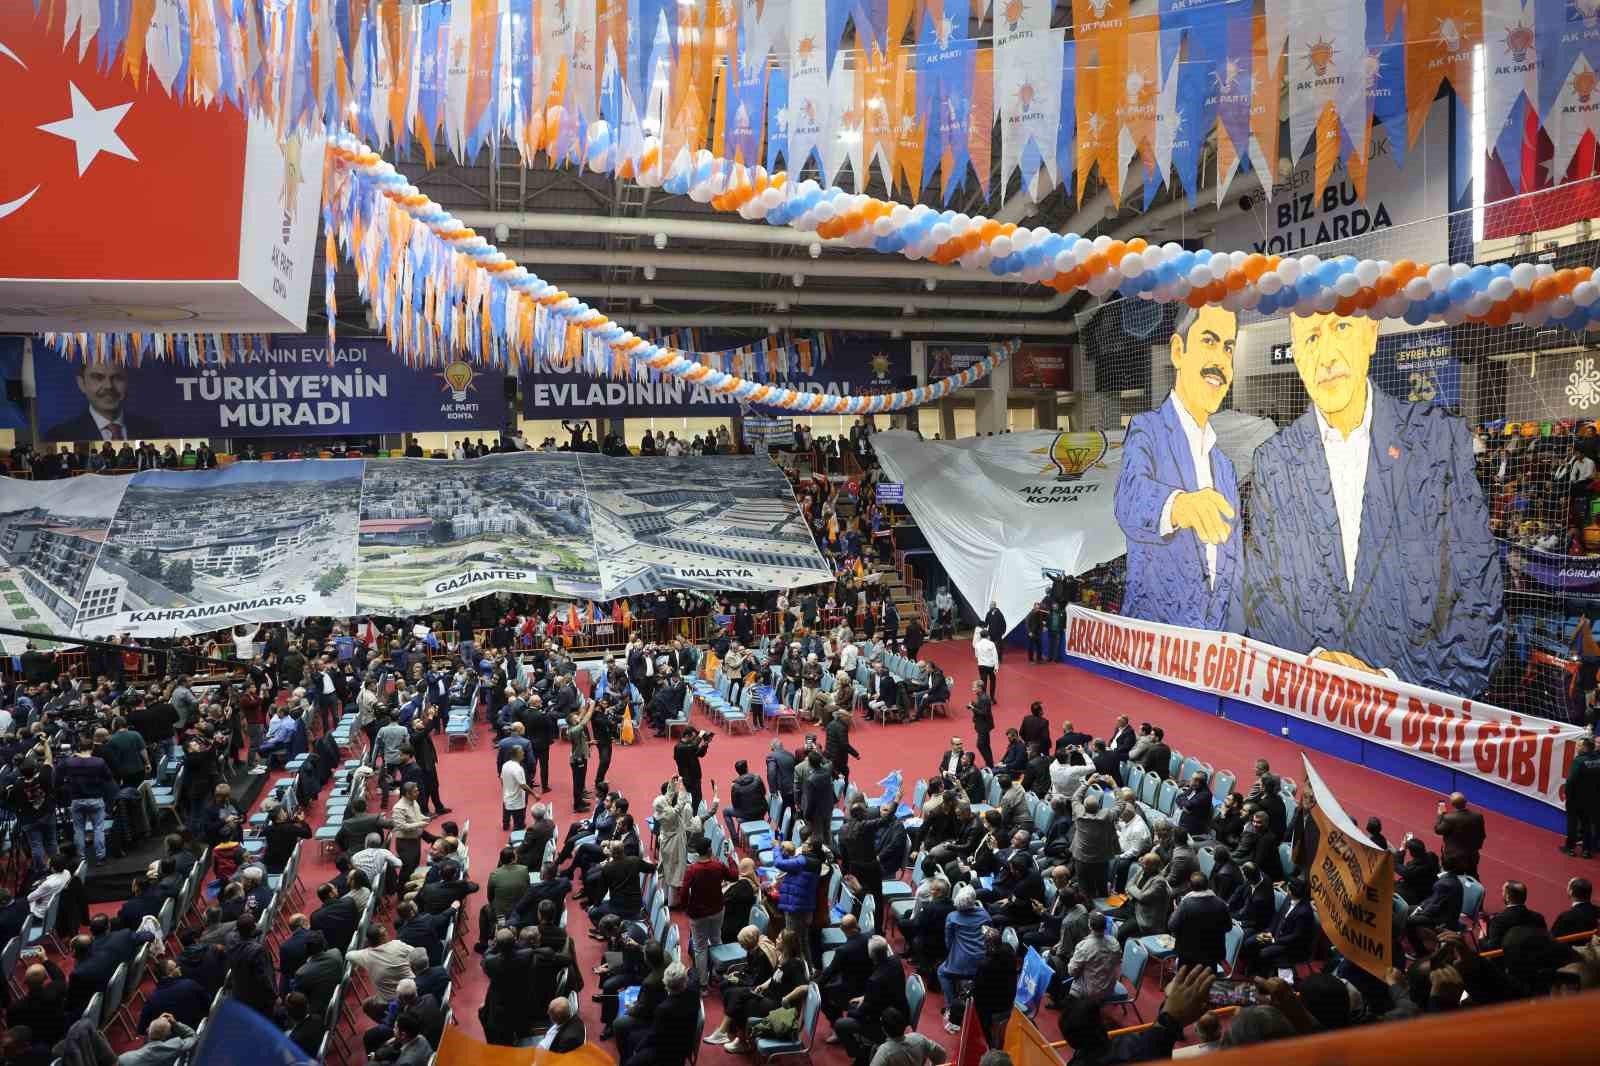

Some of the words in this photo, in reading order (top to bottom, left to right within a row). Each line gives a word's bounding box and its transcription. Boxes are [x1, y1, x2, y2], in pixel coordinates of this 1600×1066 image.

[1297, 81, 1312, 91] AK
[1277, 192, 1315, 229] BİZ
[1322, 181, 1358, 213] BU
[1253, 202, 1393, 256] YOLLARDA
[200, 349, 297, 364] ONYA'NIN
[176, 368, 388, 401] TÜRKİYE'NİN
[534, 383, 683, 407] EVLADININ
[219, 402, 350, 428] MURADI
[1018, 485, 1045, 495] AK
[1050, 483, 1101, 495] PARTİ
[1026, 495, 1079, 504] KONYA
[434, 568, 527, 593] GAZİANTEP
[681, 569, 753, 577] MALATYA
[129, 594, 307, 623] KAHRAMANMARAŞ
[1067, 616, 1156, 670] ARKANDAYIZ
[1157, 635, 1200, 683] KALE
[1203, 635, 1257, 697] GİBİ!
[1262, 655, 1400, 741] SEVİYORUZ
[1401, 696, 1472, 764] DELİ
